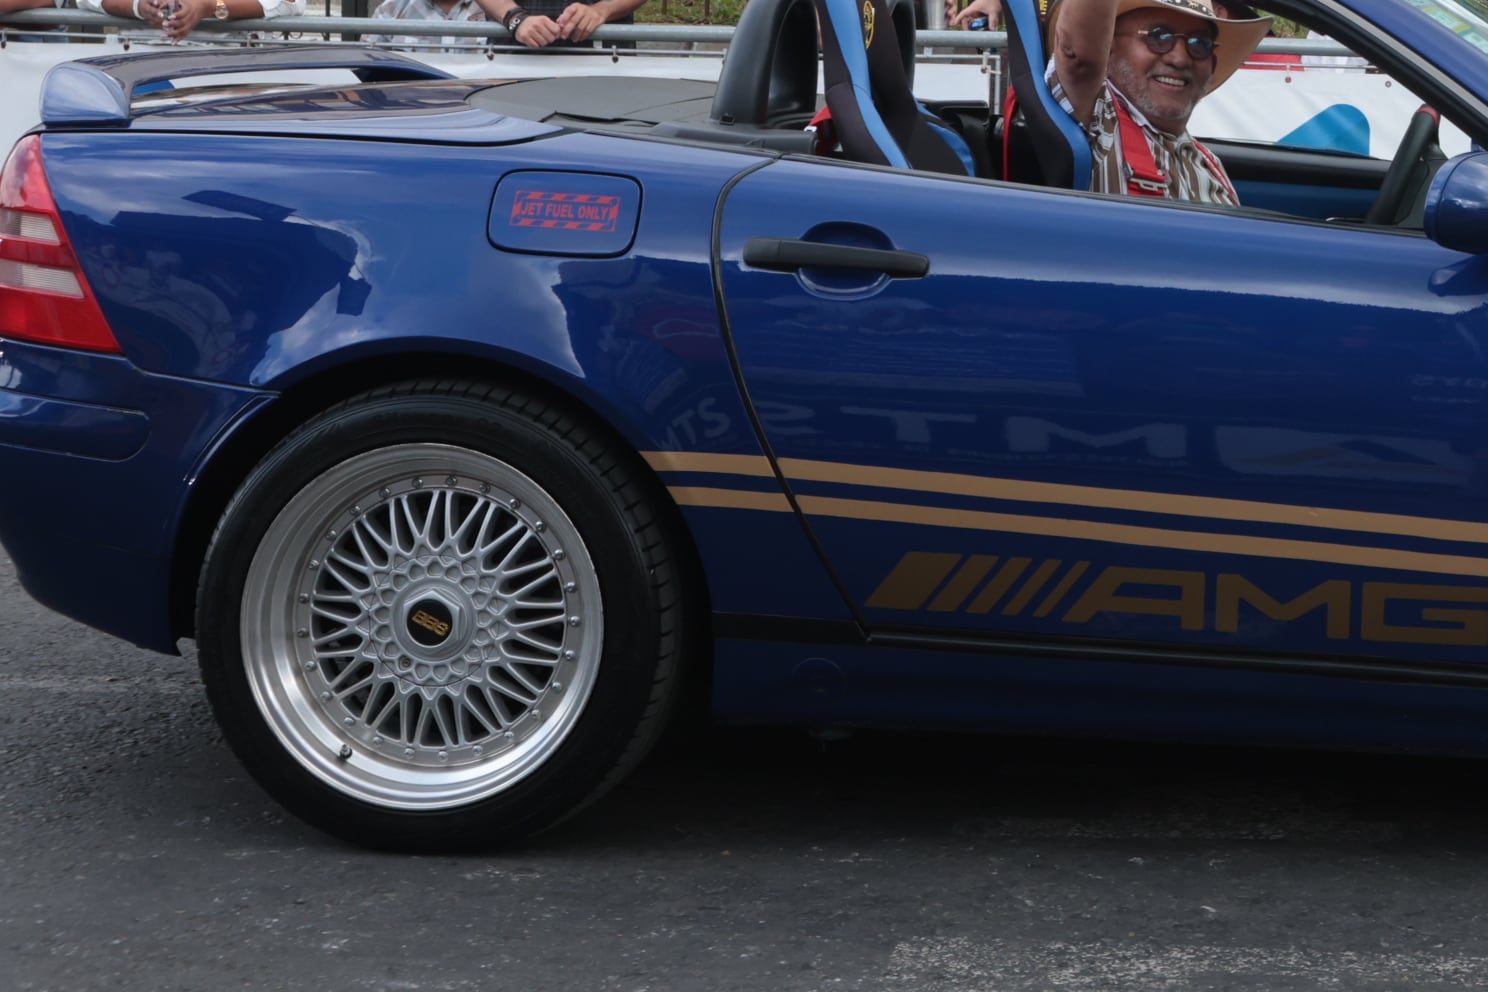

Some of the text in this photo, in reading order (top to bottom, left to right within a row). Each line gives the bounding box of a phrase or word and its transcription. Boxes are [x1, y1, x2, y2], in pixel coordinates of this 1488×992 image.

[520, 202, 610, 220] JET FUEL ONLY
[411, 609, 450, 637] BBS
